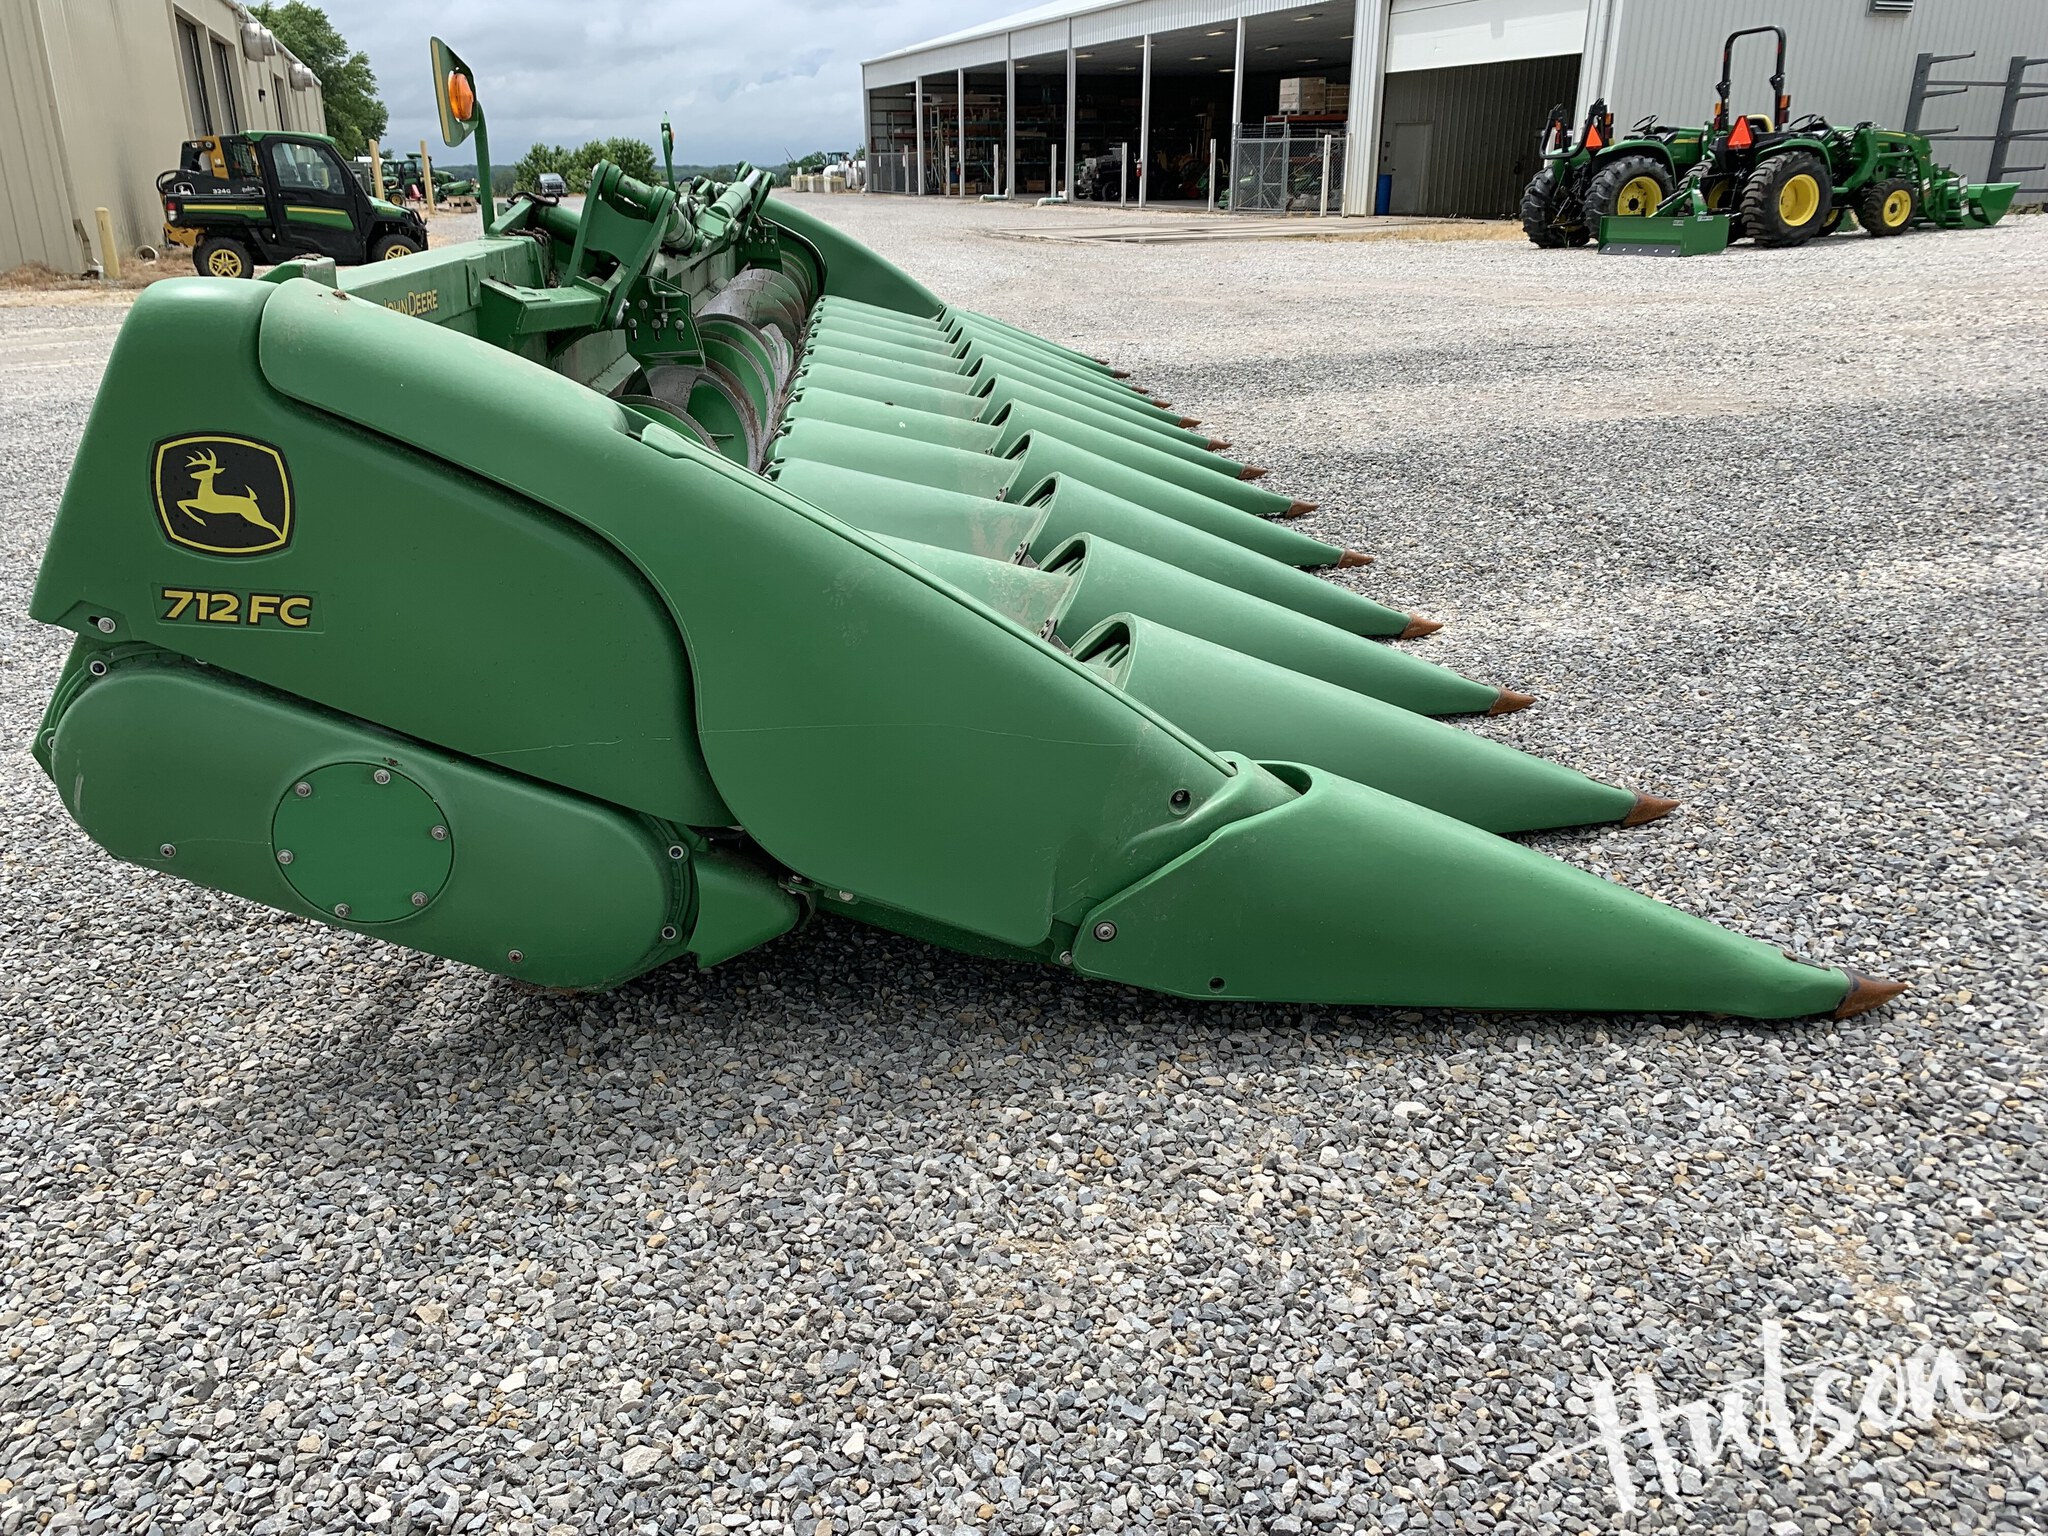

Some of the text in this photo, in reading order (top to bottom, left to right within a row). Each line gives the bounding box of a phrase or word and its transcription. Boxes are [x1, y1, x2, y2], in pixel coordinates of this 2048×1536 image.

[407, 289, 439, 316] DEERE
[162, 587, 313, 628] 712 FC
